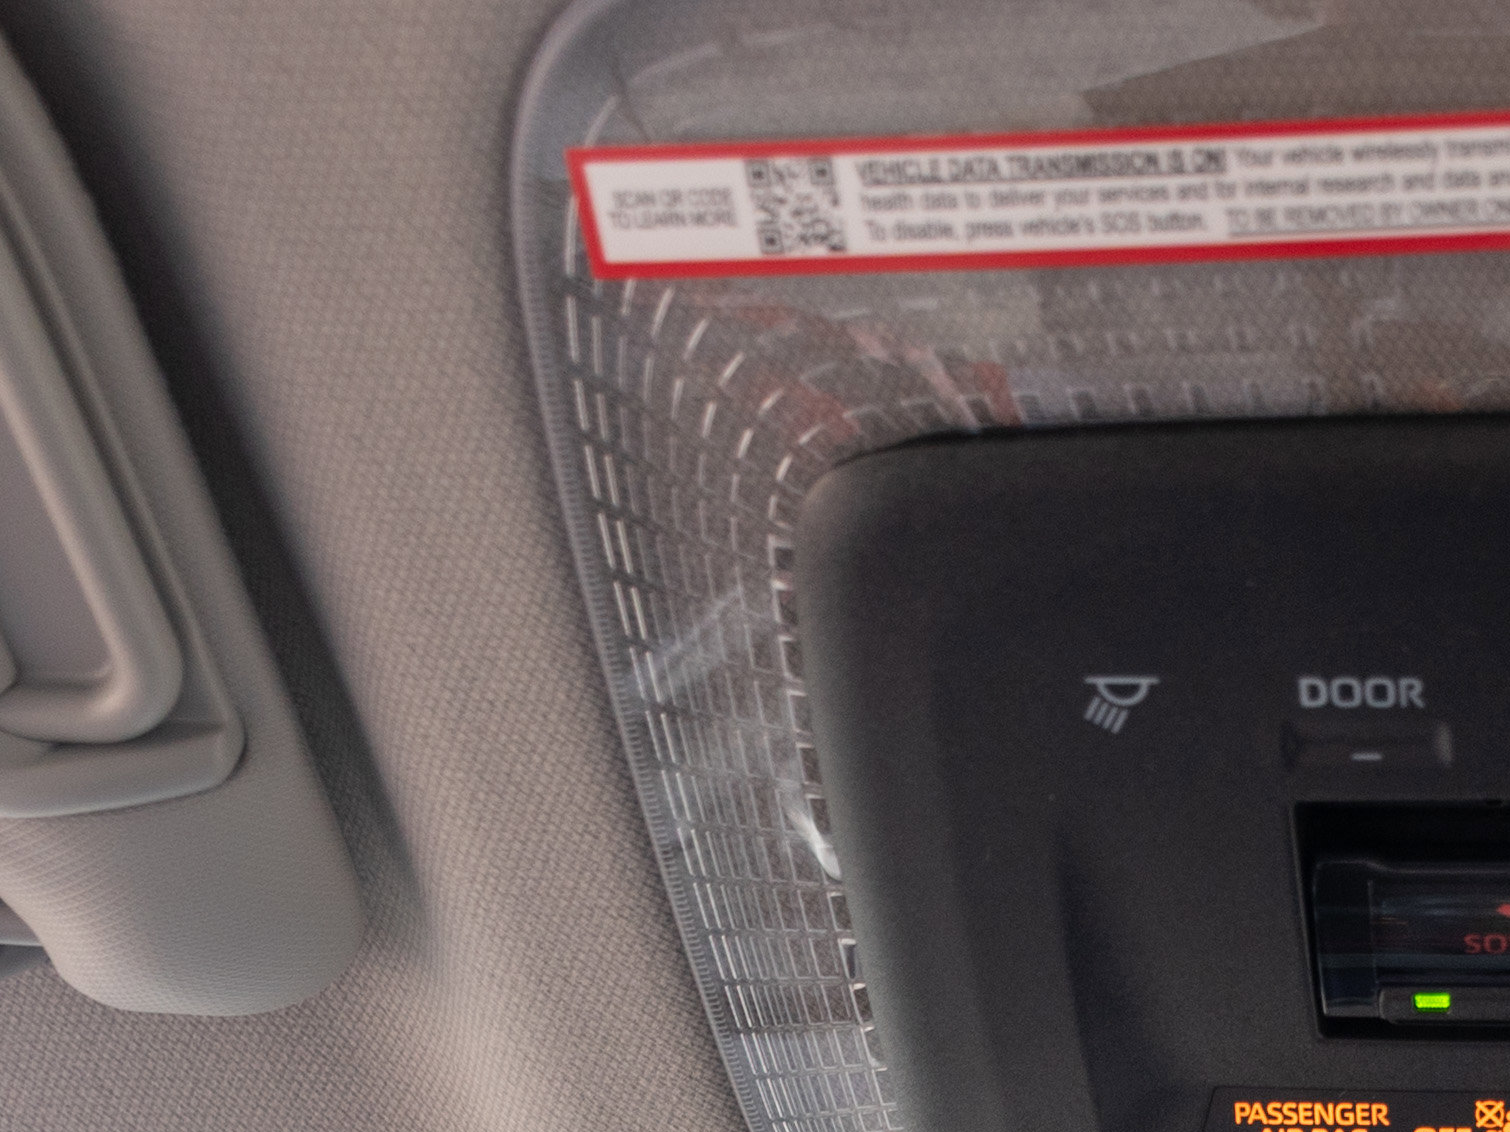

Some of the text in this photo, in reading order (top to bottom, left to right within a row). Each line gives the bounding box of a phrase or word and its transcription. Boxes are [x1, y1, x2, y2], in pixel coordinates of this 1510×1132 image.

[856, 158, 942, 186] VEHICLE
[949, 156, 999, 183] DATA
[1005, 150, 1161, 181] TRANSMISSION
[1281, 145, 1344, 165] vehicle
[1352, 141, 1438, 168] wirelessly
[687, 187, 733, 207] CODE
[861, 191, 914, 212] health
[922, 190, 957, 210] data
[964, 189, 981, 208] to
[989, 187, 1047, 208] deliver
[1052, 187, 1091, 211] your
[1098, 184, 1169, 205] services
[1176, 182, 1208, 201] and
[1245, 177, 1310, 198] internal
[1316, 172, 1395, 193] research
[1402, 171, 1435, 190] and
[1443, 168, 1482, 188] data
[607, 209, 740, 231] TO LEARN MORE
[864, 219, 887, 241] To
[965, 218, 1014, 243] press
[1100, 210, 1142, 235] SOS
[1283, 204, 1376, 230] REMOVED
[1298, 676, 1426, 709] DOOR
[1234, 1101, 1391, 1127] PASSENGER
